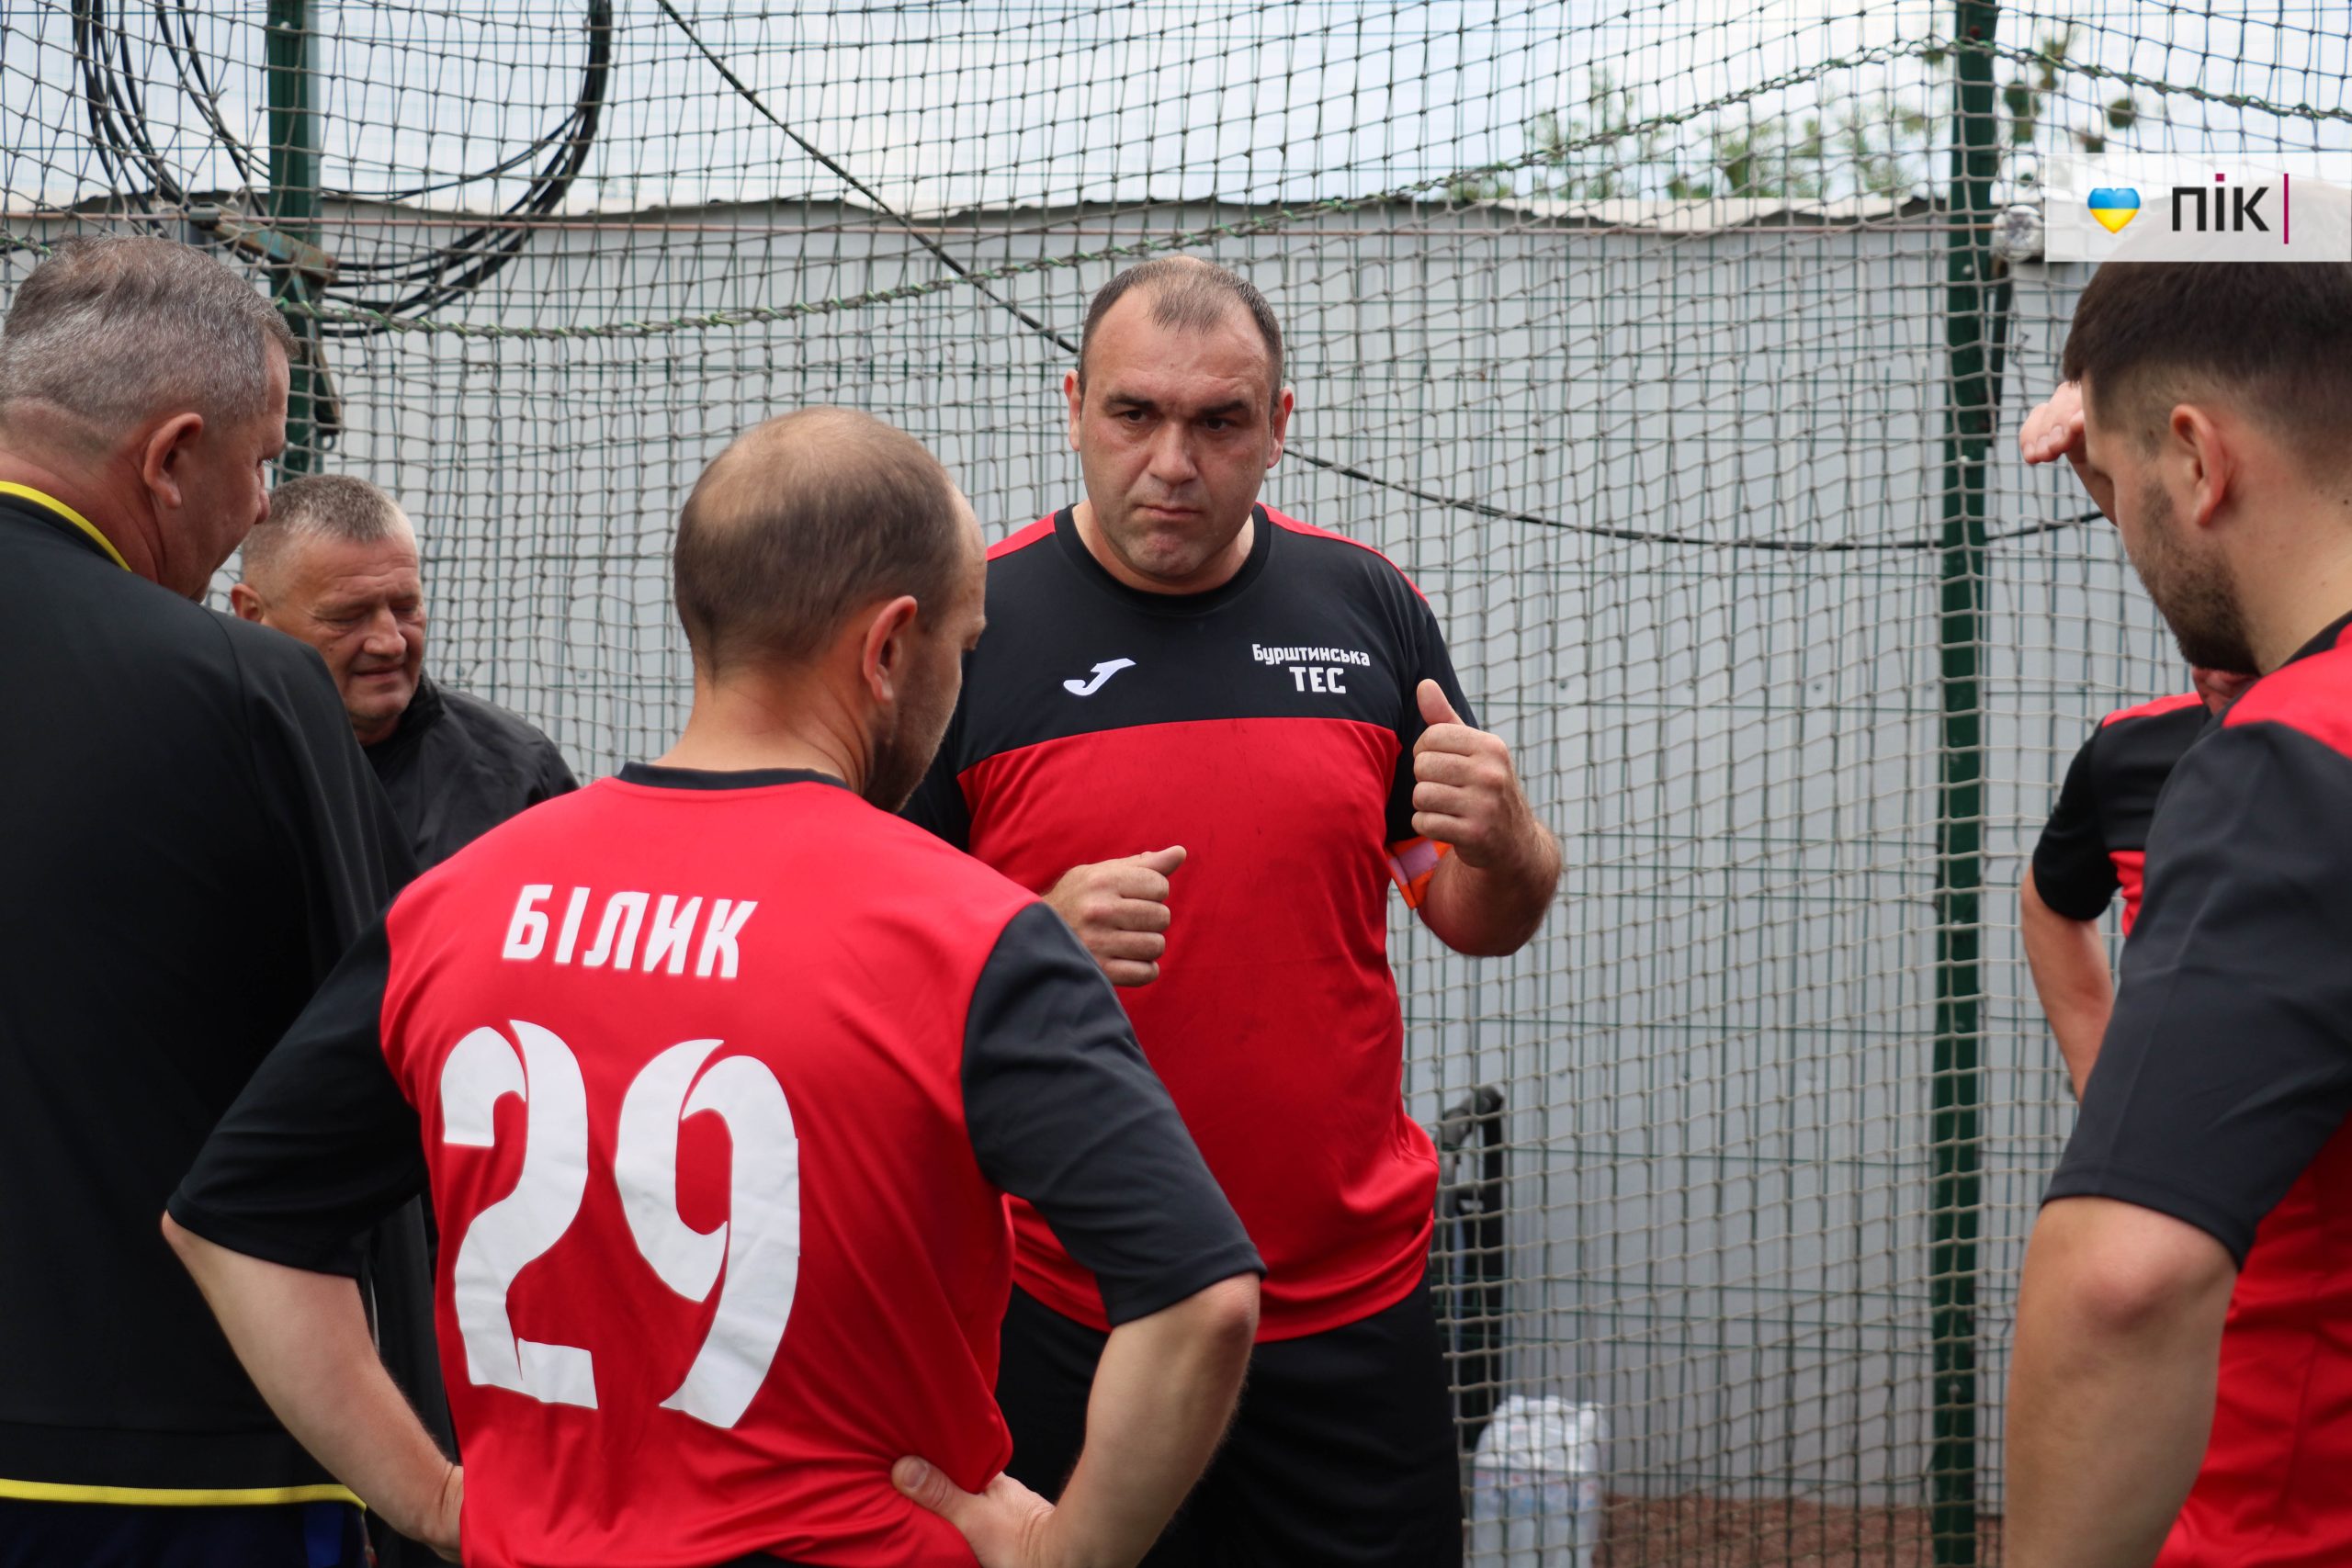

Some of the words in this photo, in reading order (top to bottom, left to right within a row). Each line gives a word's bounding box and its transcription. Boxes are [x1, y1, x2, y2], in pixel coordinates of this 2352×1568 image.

[1251, 643, 1371, 667] Бурштинська
[1288, 666, 1347, 694] ТЕС
[502, 884, 759, 979] БІЛИК
[440, 1019, 800, 1429] 29
